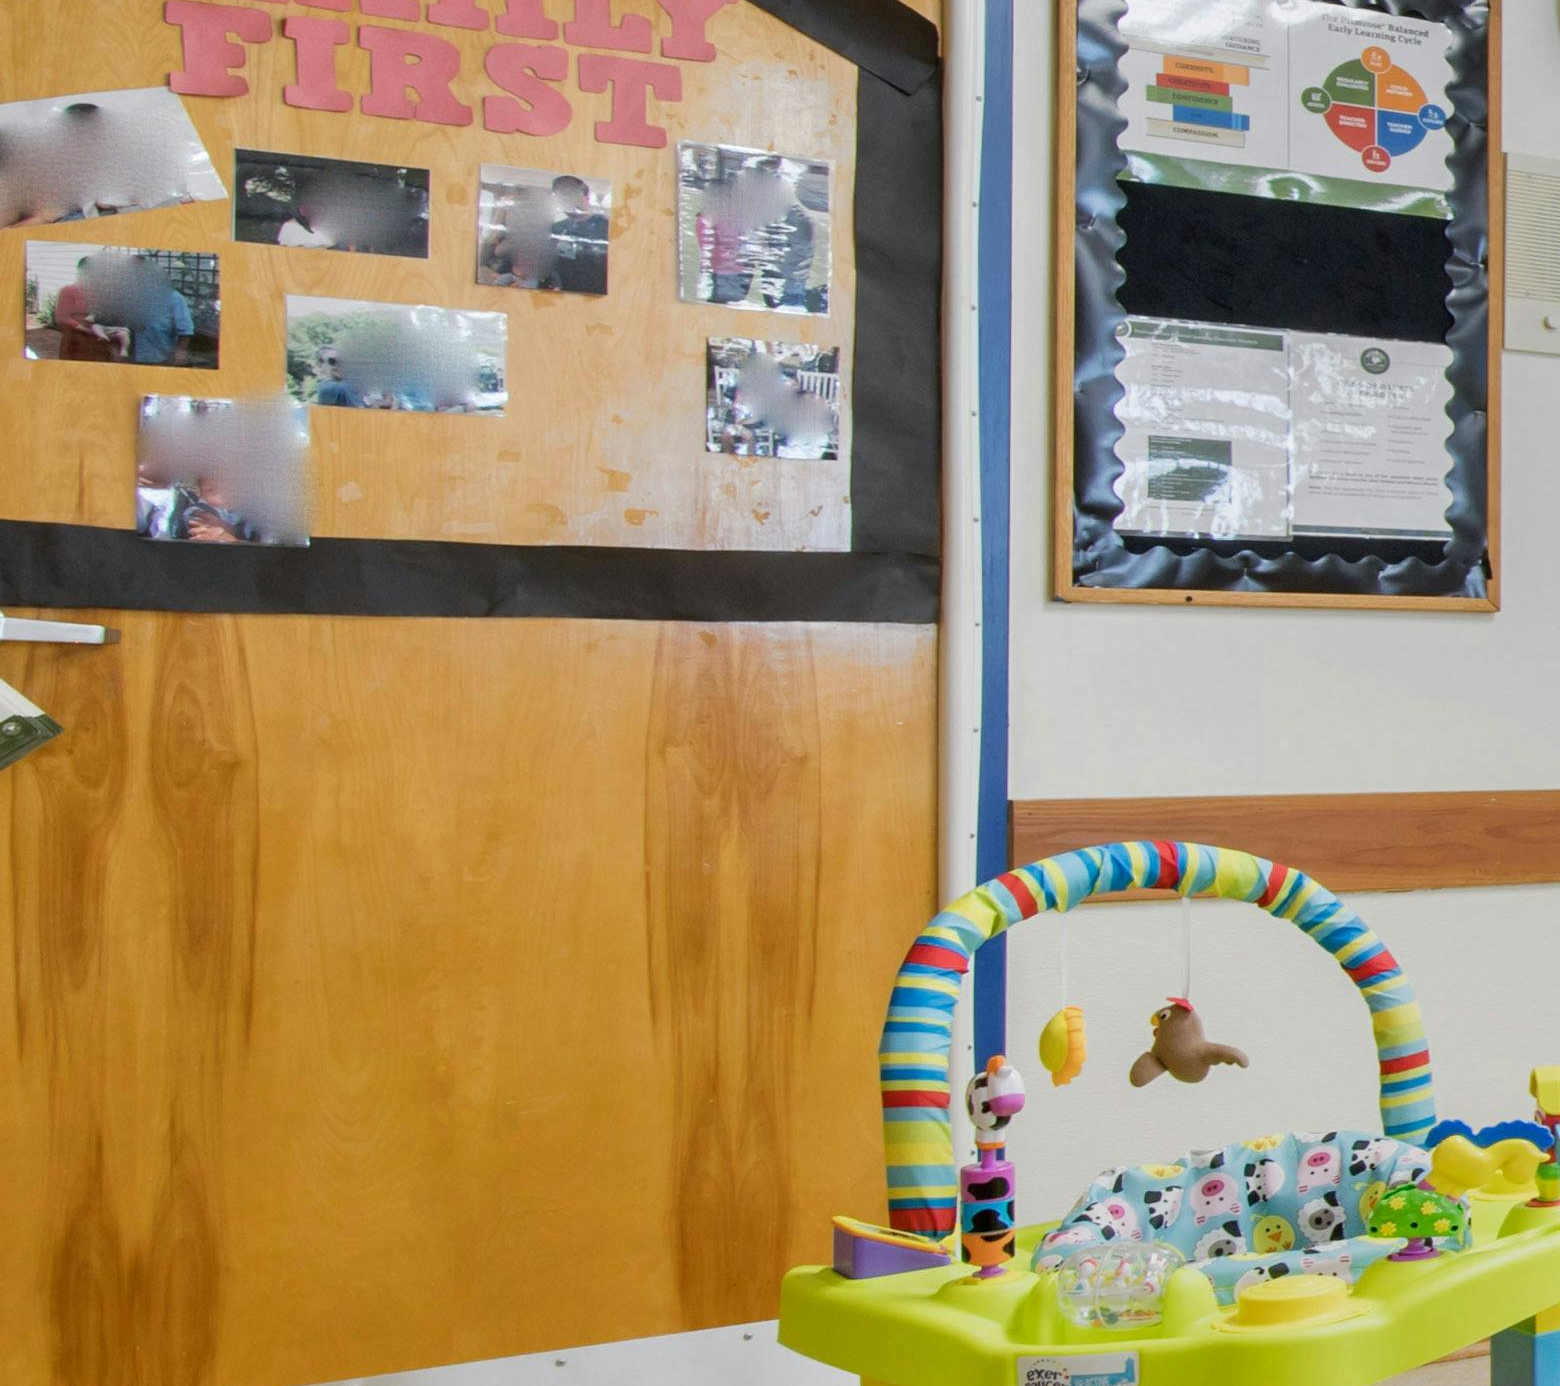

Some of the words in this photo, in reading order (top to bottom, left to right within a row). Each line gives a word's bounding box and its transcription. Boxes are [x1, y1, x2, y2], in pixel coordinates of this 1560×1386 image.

[1328, 24, 1352, 35] Early
[1355, 28, 1396, 42] Learning
[1398, 36, 1422, 45] Cycle
[1389, 24, 1429, 37] Balanced
[164, 1, 683, 148] FIRST
[1026, 1369, 1063, 1381] exer
